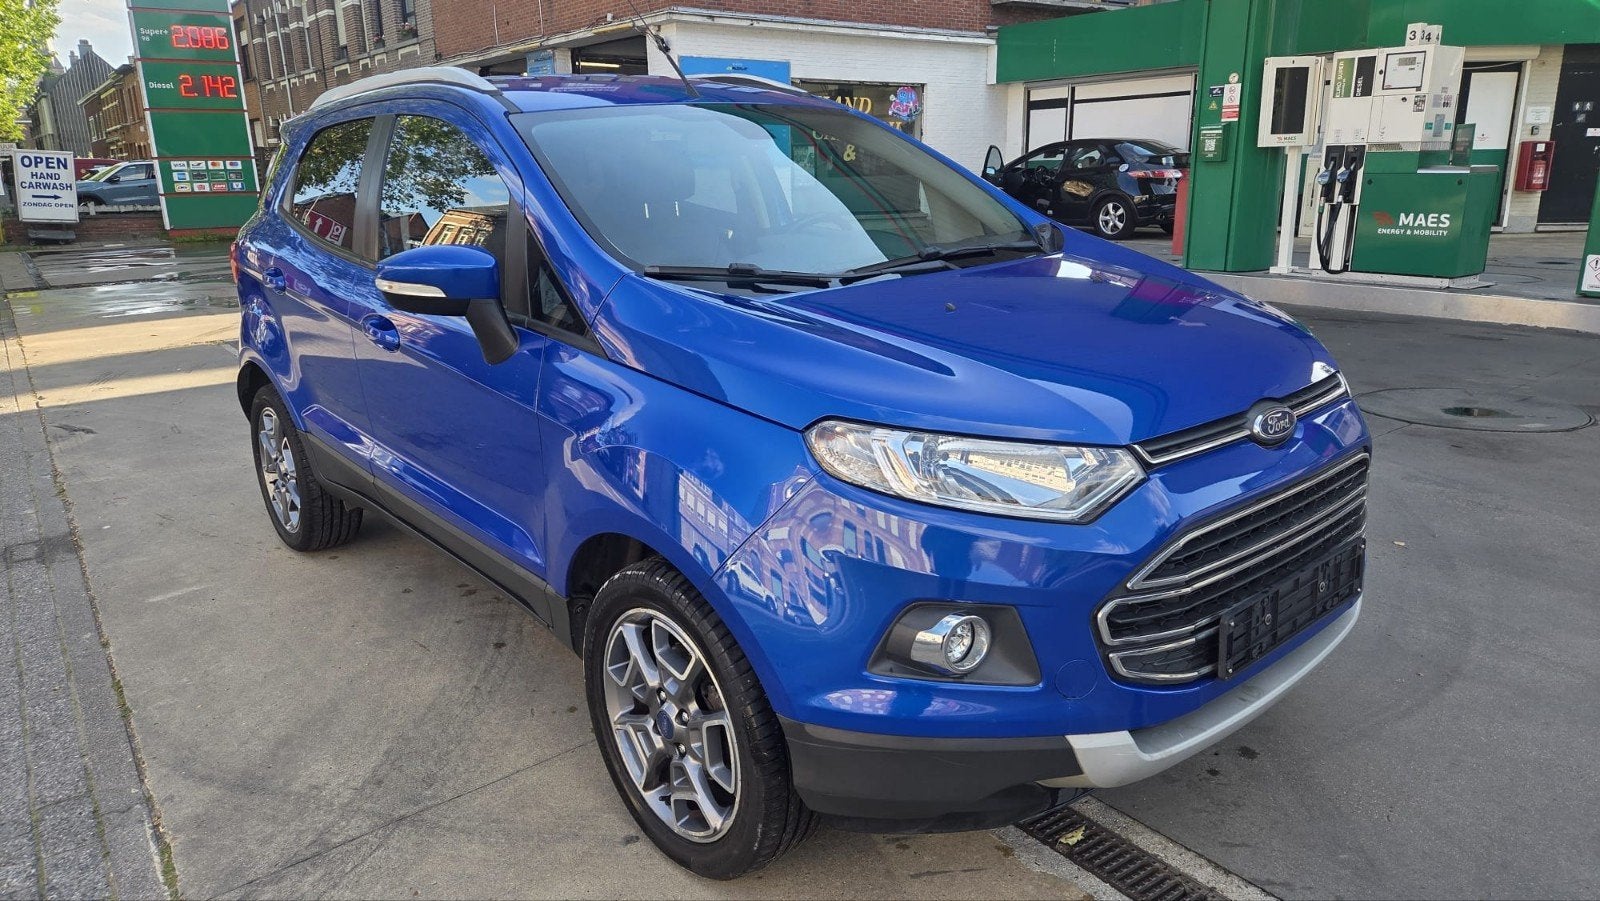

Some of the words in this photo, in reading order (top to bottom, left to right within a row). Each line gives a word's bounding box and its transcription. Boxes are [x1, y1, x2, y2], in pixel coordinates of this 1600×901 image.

[140, 27, 168, 36] Super+
[171, 24, 229, 49] 2.086
[1409, 30, 1417, 40] 3
[1425, 32, 1431, 42] 4
[149, 81, 174, 89] Diesel
[179, 74, 237, 98] 2.142
[818, 96, 872, 114] AND
[843, 144, 856, 161] &
[20, 155, 68, 170] OPEN
[31, 172, 60, 180] HAND
[20, 181, 73, 191] CARWASH
[1398, 212, 1451, 228] MAES
[1268, 412, 1290, 434] Ford
